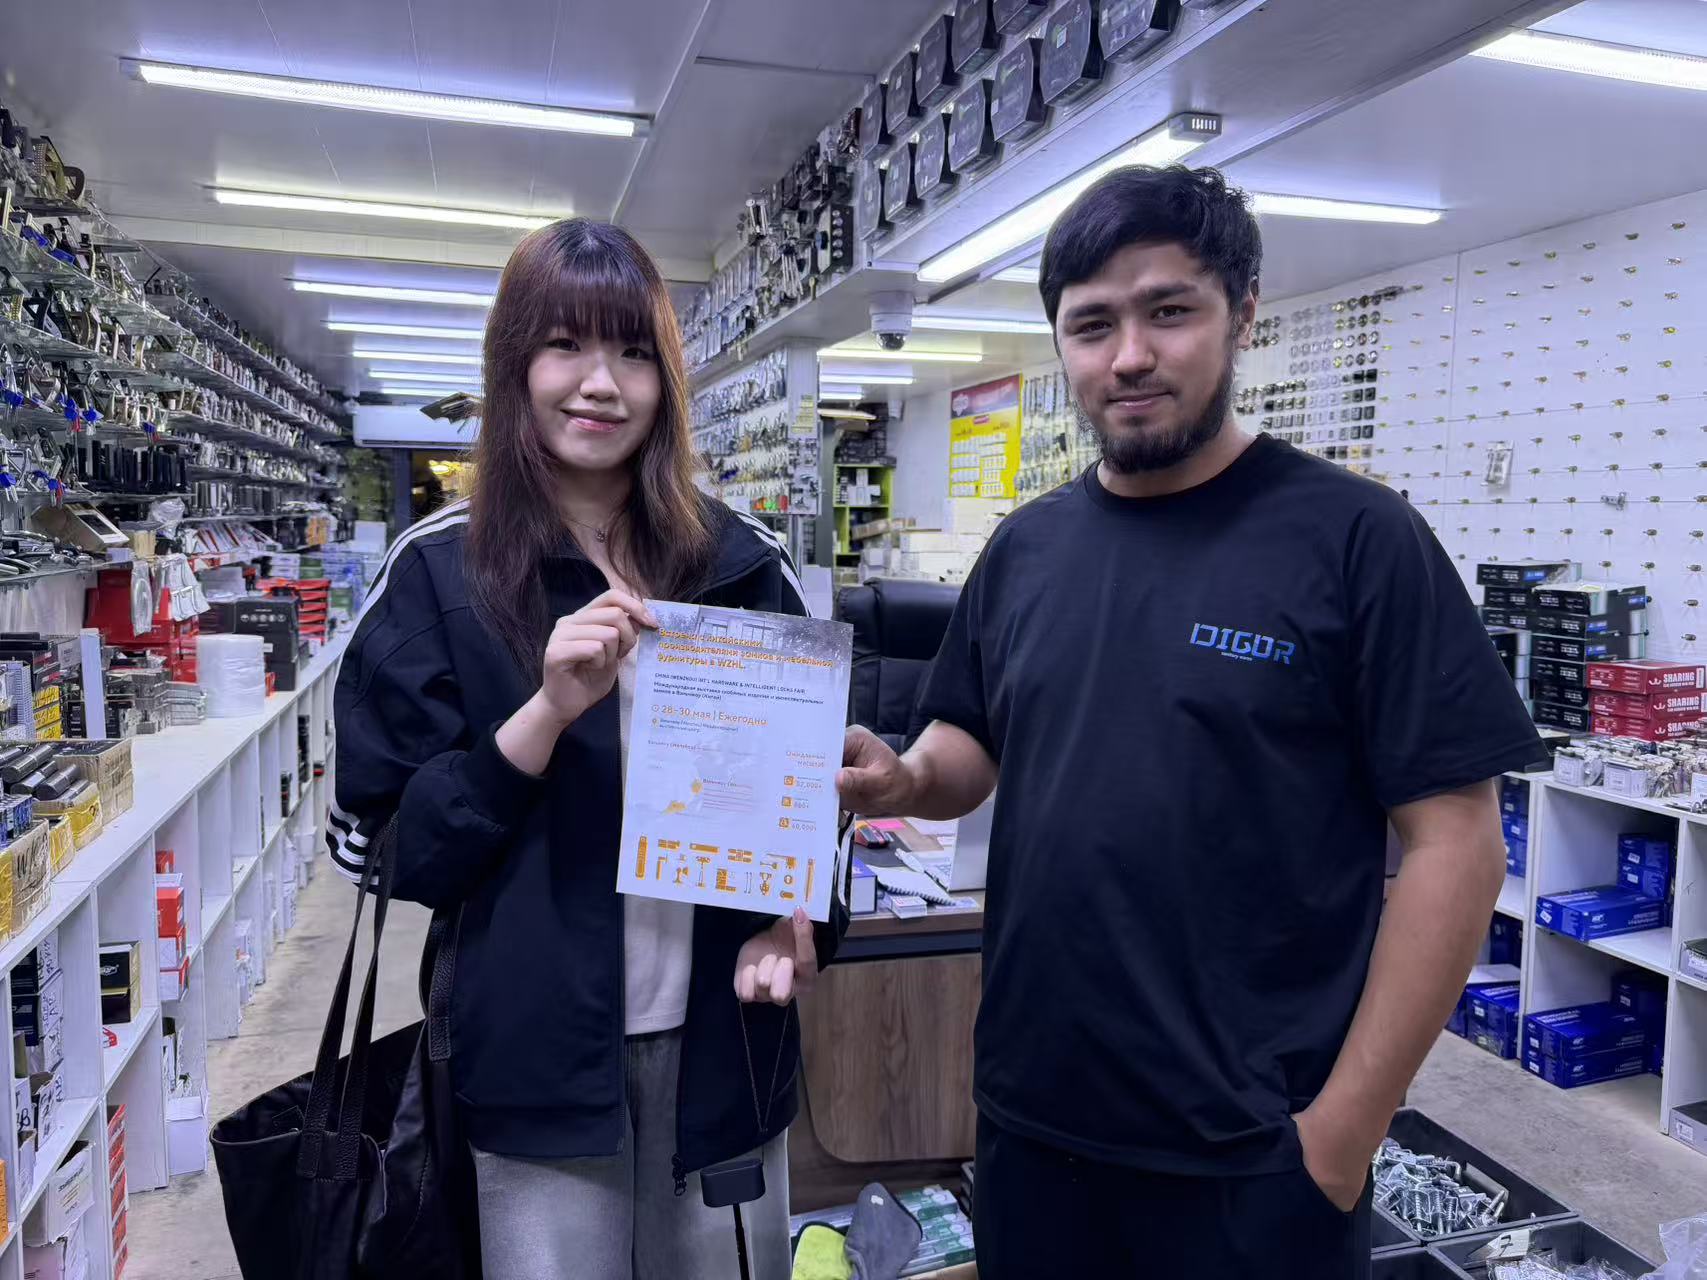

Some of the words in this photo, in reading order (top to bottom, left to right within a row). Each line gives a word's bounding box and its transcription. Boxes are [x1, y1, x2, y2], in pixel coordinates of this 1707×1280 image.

[1190, 623, 1296, 665] DIGOR
[1662, 671, 1696, 683] SHARING
[1667, 696, 1700, 708] SHARING
[692, 711, 712, 719] мая
[1500, 1234, 1514, 1257] 7
